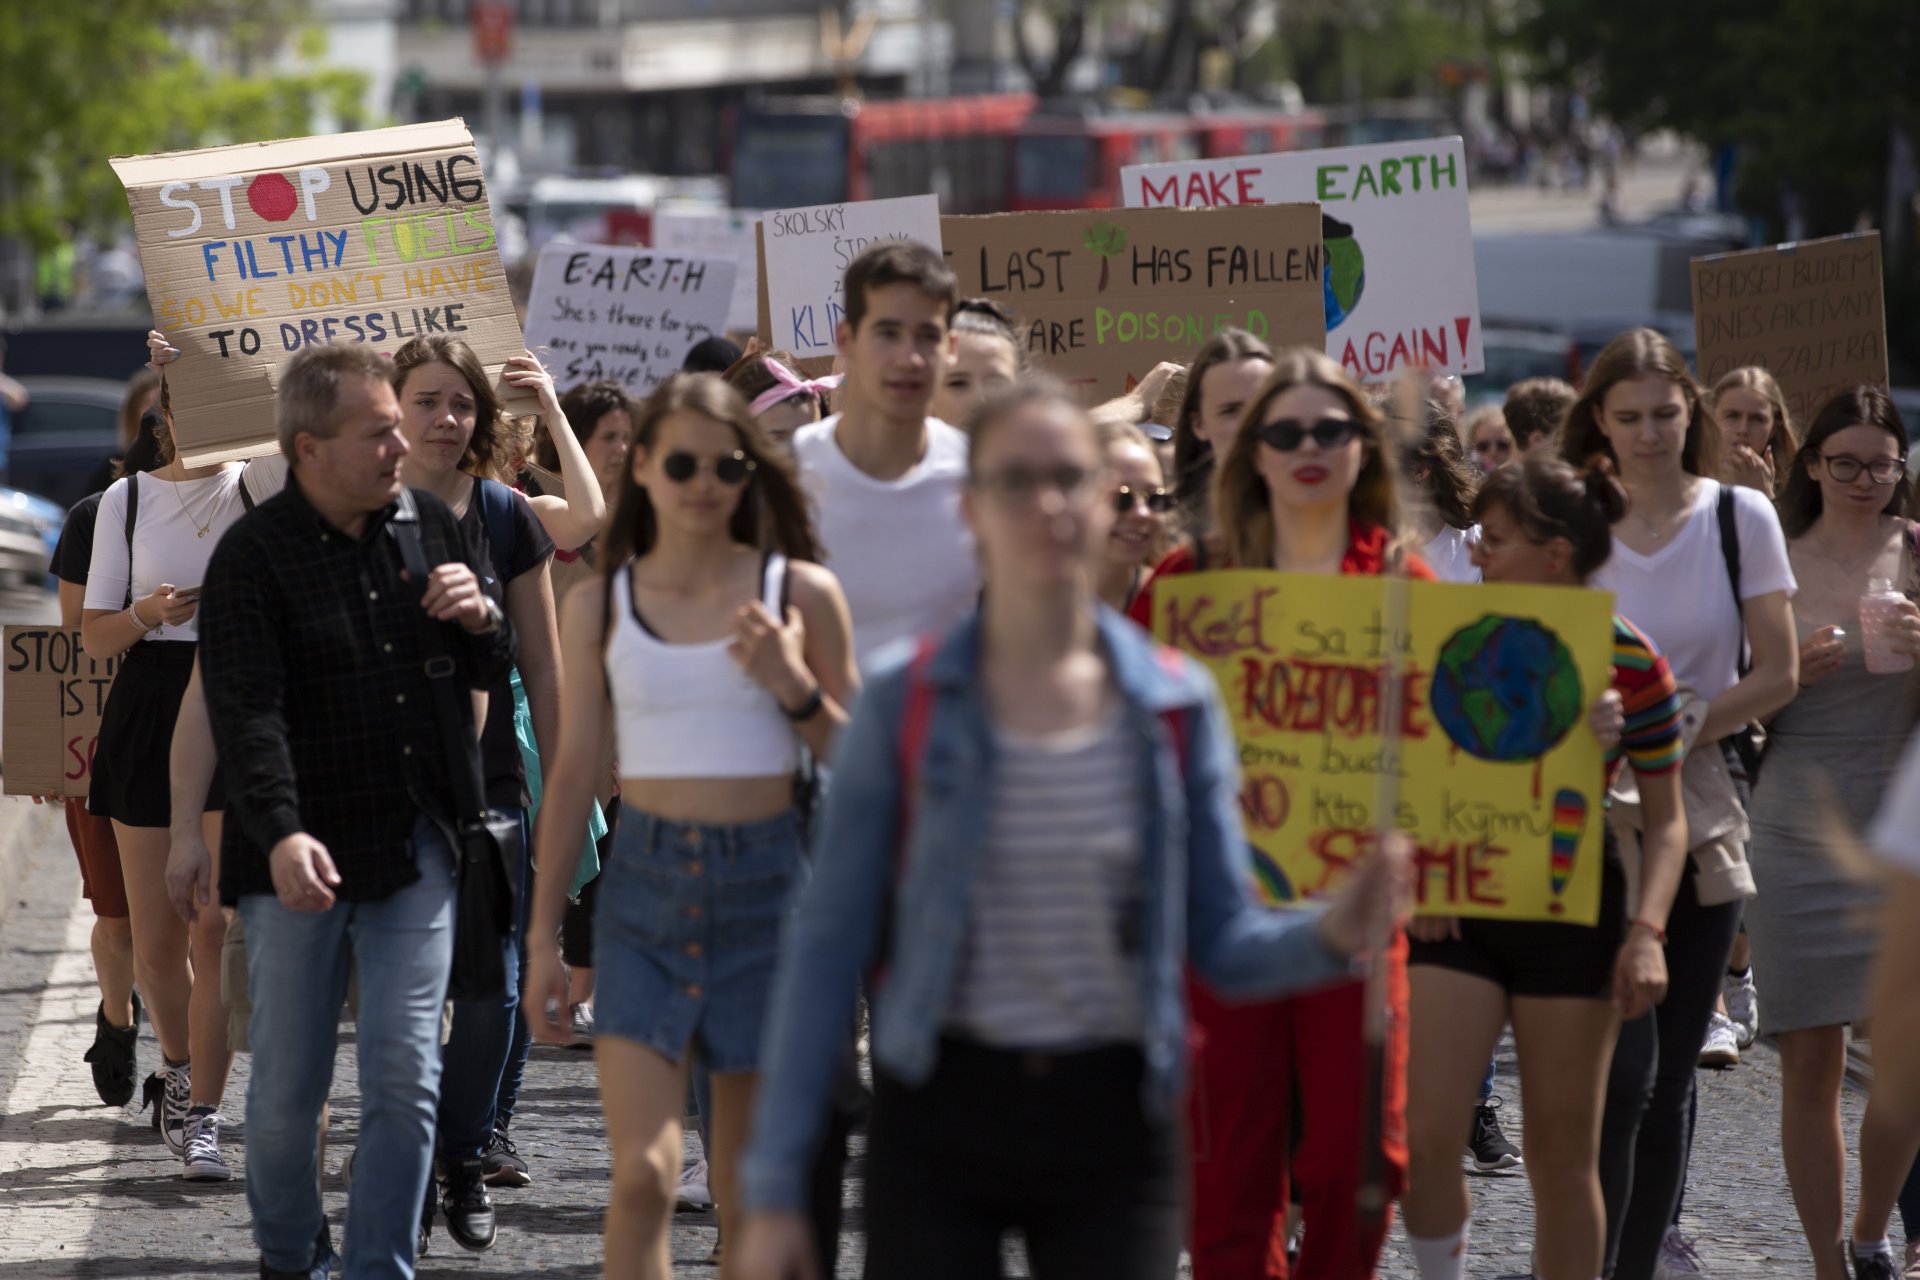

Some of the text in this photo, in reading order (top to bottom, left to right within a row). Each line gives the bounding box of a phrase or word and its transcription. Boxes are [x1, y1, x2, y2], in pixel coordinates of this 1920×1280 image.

[159, 155, 483, 238] STOP USING
[1141, 153, 1457, 207] MAKE EARTH
[203, 205, 496, 281] FILTHY FUELS
[774, 205, 845, 237] ŠKOLSKÝ
[980, 244, 1320, 292] LAST HAS FALLEN
[1792, 250, 1875, 289] BUDEM
[161, 259, 496, 331] SO WE DON'T HAVE
[552, 296, 598, 323] She's
[208, 303, 468, 358] TO DRESS LIKE
[550, 337, 577, 352] are
[585, 341, 608, 359] you
[1029, 306, 1268, 355] ARE POISONED
[1341, 316, 1472, 376] AGAIN!
[1701, 304, 1764, 348] DNES
[1777, 331, 1878, 379] ZAJTRA
[60, 679, 84, 718] IS
